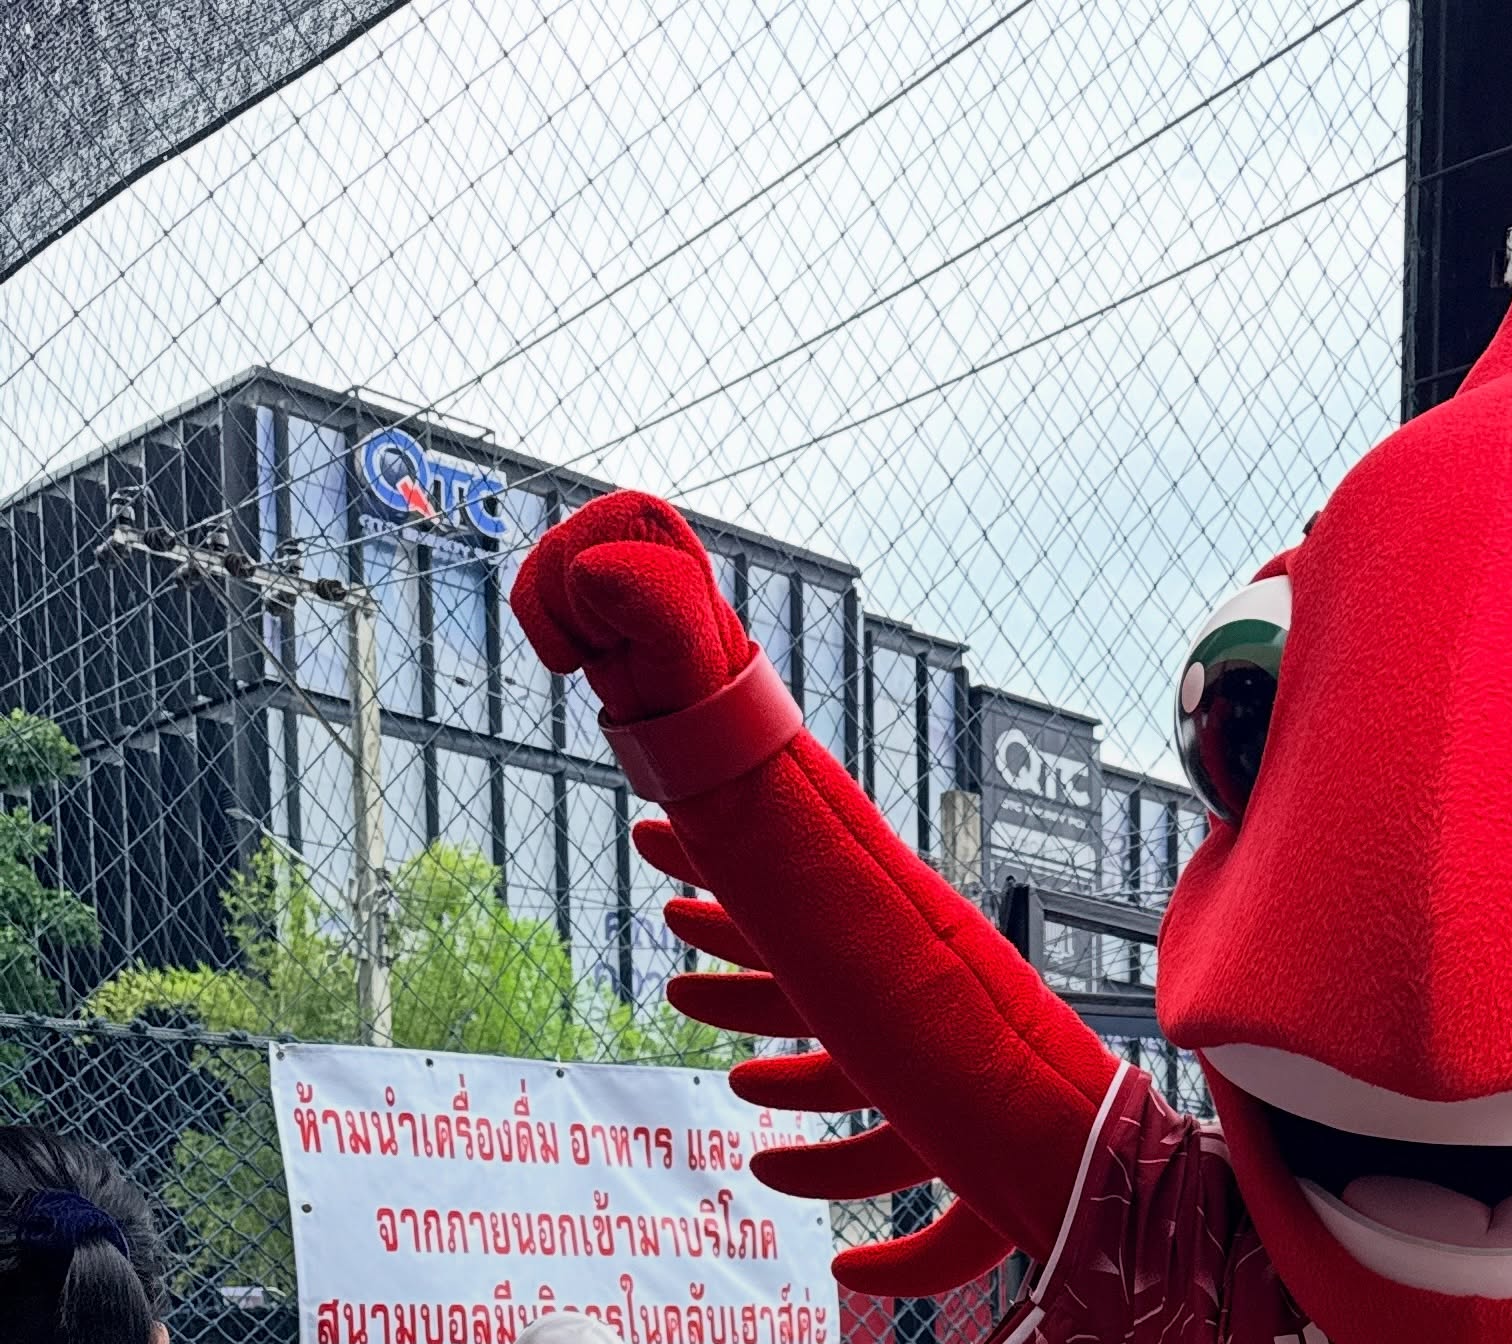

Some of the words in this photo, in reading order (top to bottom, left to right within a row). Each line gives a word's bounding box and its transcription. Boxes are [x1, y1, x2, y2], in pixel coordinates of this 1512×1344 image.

[362, 427, 508, 540] QTC
[995, 728, 1091, 806] QTC
[294, 1073, 559, 1165] ห้ามนำเครื่องดื่ม
[570, 1123, 673, 1170] อาหาร
[687, 1127, 743, 1171] และ
[376, 1189, 778, 1260] จากภายนอกเข้ามาบริโภค
